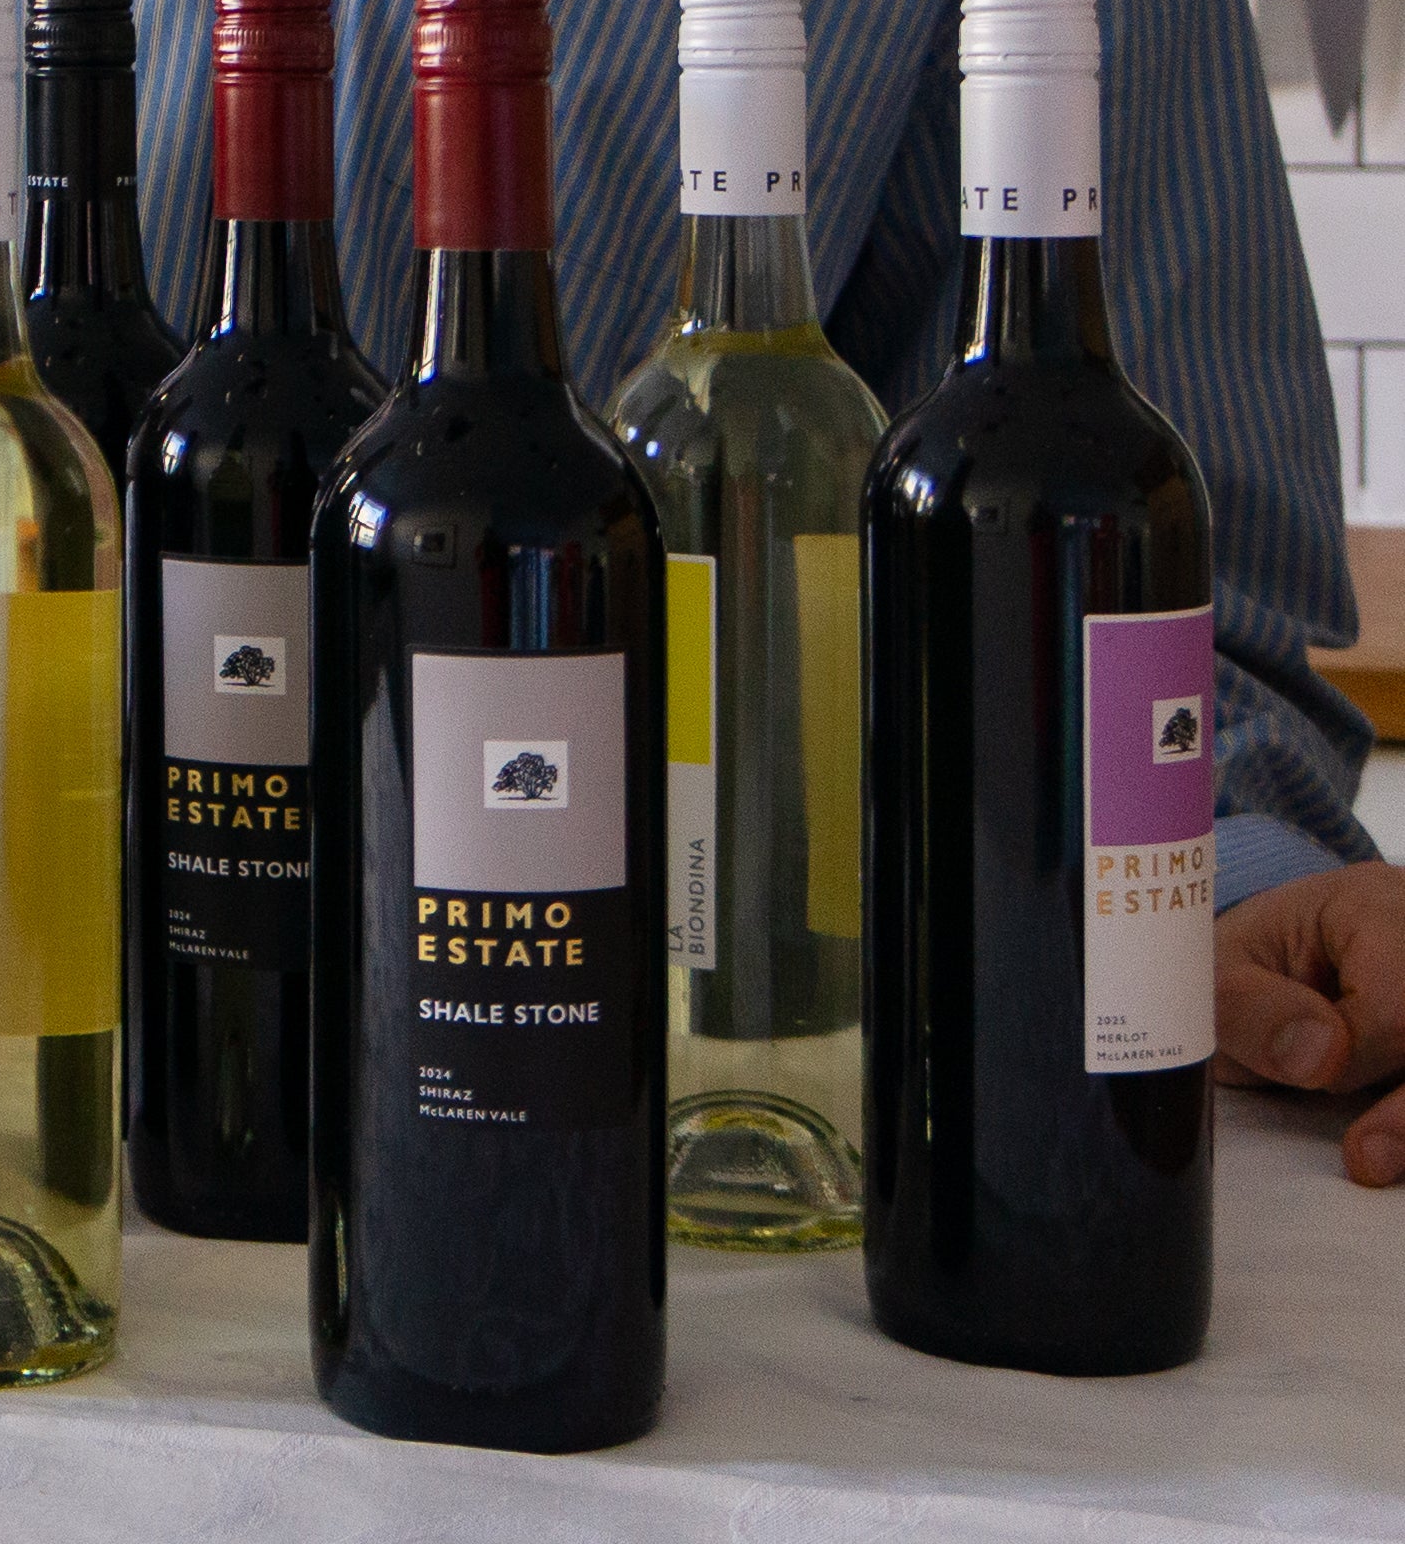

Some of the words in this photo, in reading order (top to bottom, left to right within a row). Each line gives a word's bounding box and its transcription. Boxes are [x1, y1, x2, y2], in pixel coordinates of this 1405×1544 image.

[167, 765, 289, 798] PRIMO
[167, 797, 301, 831] ESTATE
[167, 851, 230, 876] SHALE
[1096, 845, 1203, 880] PRIMO
[688, 837, 705, 956] BIONDINA
[1096, 878, 1208, 916] ESTATE
[417, 897, 572, 930] PRIMO
[168, 924, 207, 940] SHIRAZ
[668, 924, 683, 954] LA
[168, 939, 217, 957] McLAREN
[219, 947, 250, 961] VALE
[417, 933, 584, 967] ESTATE
[418, 997, 505, 1025] SHALE
[513, 1001, 601, 1026] STONE
[1096, 1015, 1127, 1026] 2025
[1096, 1031, 1149, 1044] MERLOT
[1096, 1049, 1155, 1062] McLAREN
[1158, 1043, 1184, 1057] VALE
[418, 1065, 452, 1081] 2024
[418, 1084, 474, 1102] SHIRAZ
[418, 1103, 486, 1121] McLAREN
[490, 1109, 527, 1123] VALE
